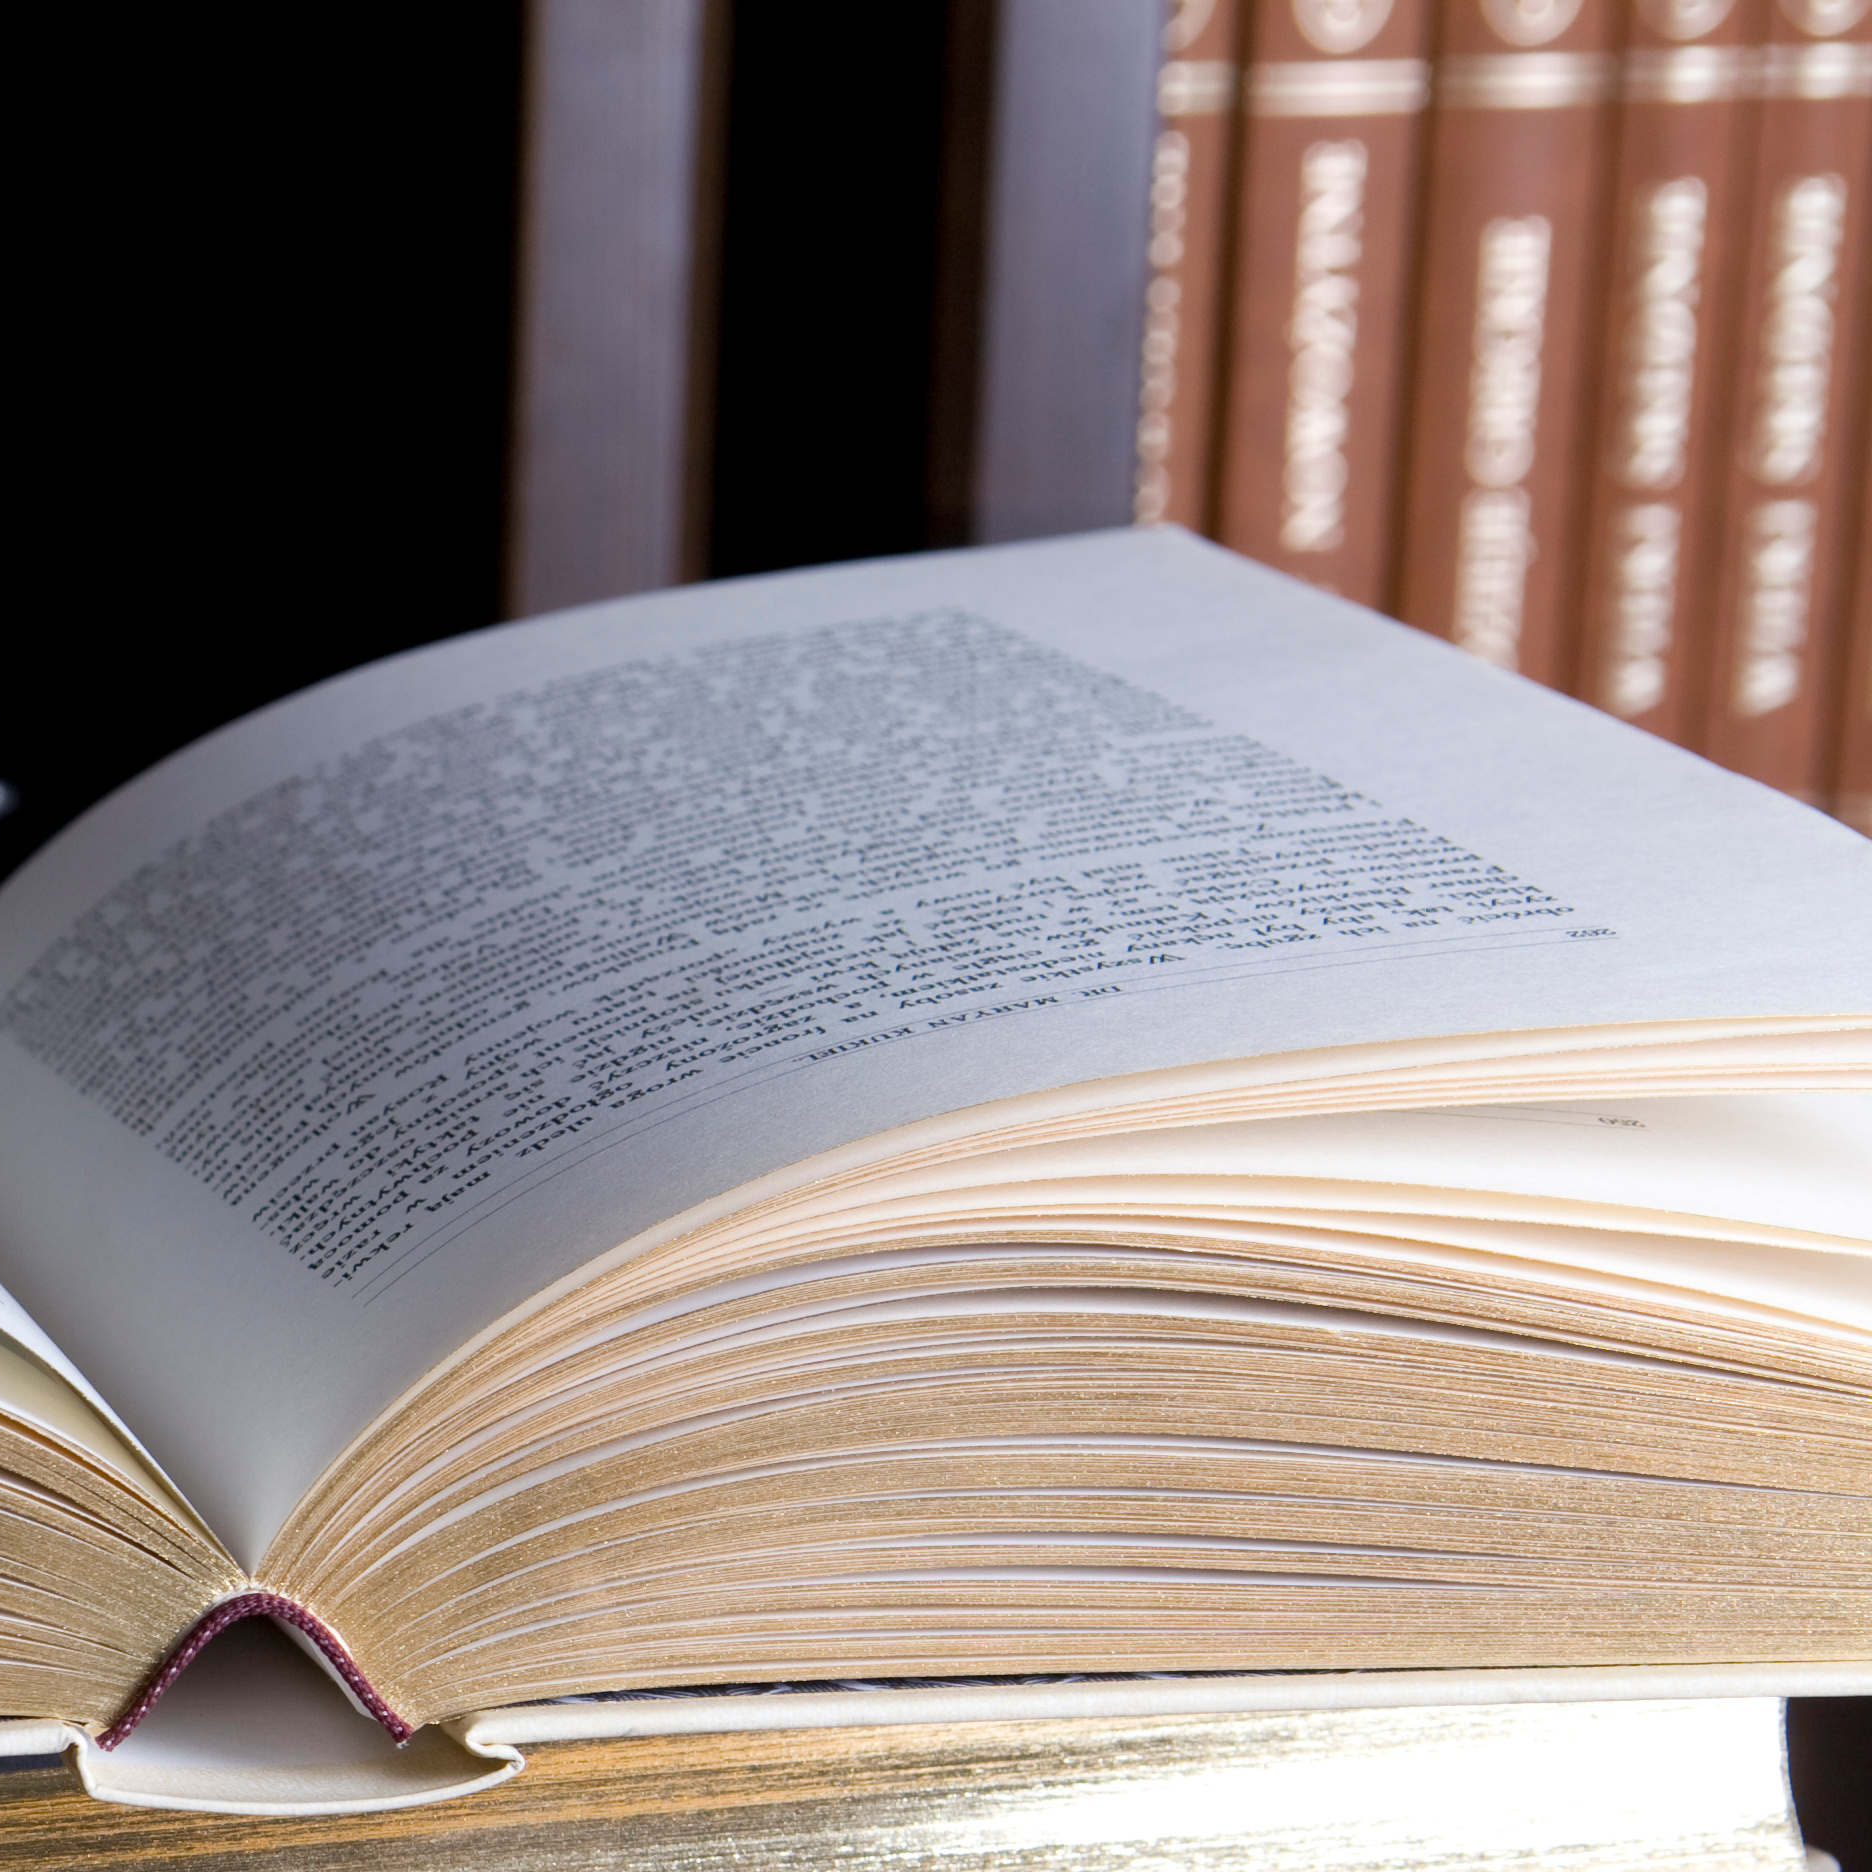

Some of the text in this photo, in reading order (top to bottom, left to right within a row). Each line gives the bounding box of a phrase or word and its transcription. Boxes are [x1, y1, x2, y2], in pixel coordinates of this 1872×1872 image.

[1371, 865, 1508, 885] Francuzi
[1428, 874, 1519, 889] chmar
[1253, 884, 1412, 909] Baszkirów
[1436, 884, 1544, 901] klęski.
[1465, 894, 1558, 910] zycyi,
[1299, 898, 1407, 916] Należy
[1321, 913, 1375, 926] aby
[1390, 904, 1454, 919] tak,
[995, 924, 1042, 939] nie
[1058, 915, 1094, 927] że
[1125, 913, 1278, 943] niepokoić
[1249, 922, 1307, 938] był
[888, 936, 981, 961] żałują
[1059, 935, 1100, 950] go
[1125, 931, 1235, 952] nękany
[808, 959, 879, 986] krwi
[855, 941, 1017, 985] rozsianych
[950, 948, 1042, 972] ciągle
[877, 950, 1106, 999] niedostatkiem,
[694, 981, 840, 1029] wszędzie,
[724, 978, 891, 1032] pochodzie,
[842, 1000, 863, 1011] a
[640, 1001, 731, 1038] należy
[790, 985, 1124, 1064] DR. MARYAN KUKIEL.
[571, 1040, 617, 1072] jąć
[663, 1013, 816, 1073] zagrożony
[567, 1034, 676, 1085] nigdzie
[586, 1035, 710, 1095] niszczyć
[332, 907, 1574, 1287] obrócić na ich zgubę. Wszystkie zasoby na froncie wroga uledz mają rekwi-
[502, 1077, 545, 1103] się
[502, 1091, 545, 1118] nie
[450, 1080, 633, 1181] ogłodzeniem
[465, 1093, 572, 1157] dowozy
[385, 1111, 480, 1181] taktyki
[418, 1162, 449, 1186] za
[298, 1126, 479, 1259] pochwytnych.
[287, 1191, 363, 1256] wręcz
[306, 1187, 409, 1271] pomocą
[320, 1227, 382, 1281] razie
